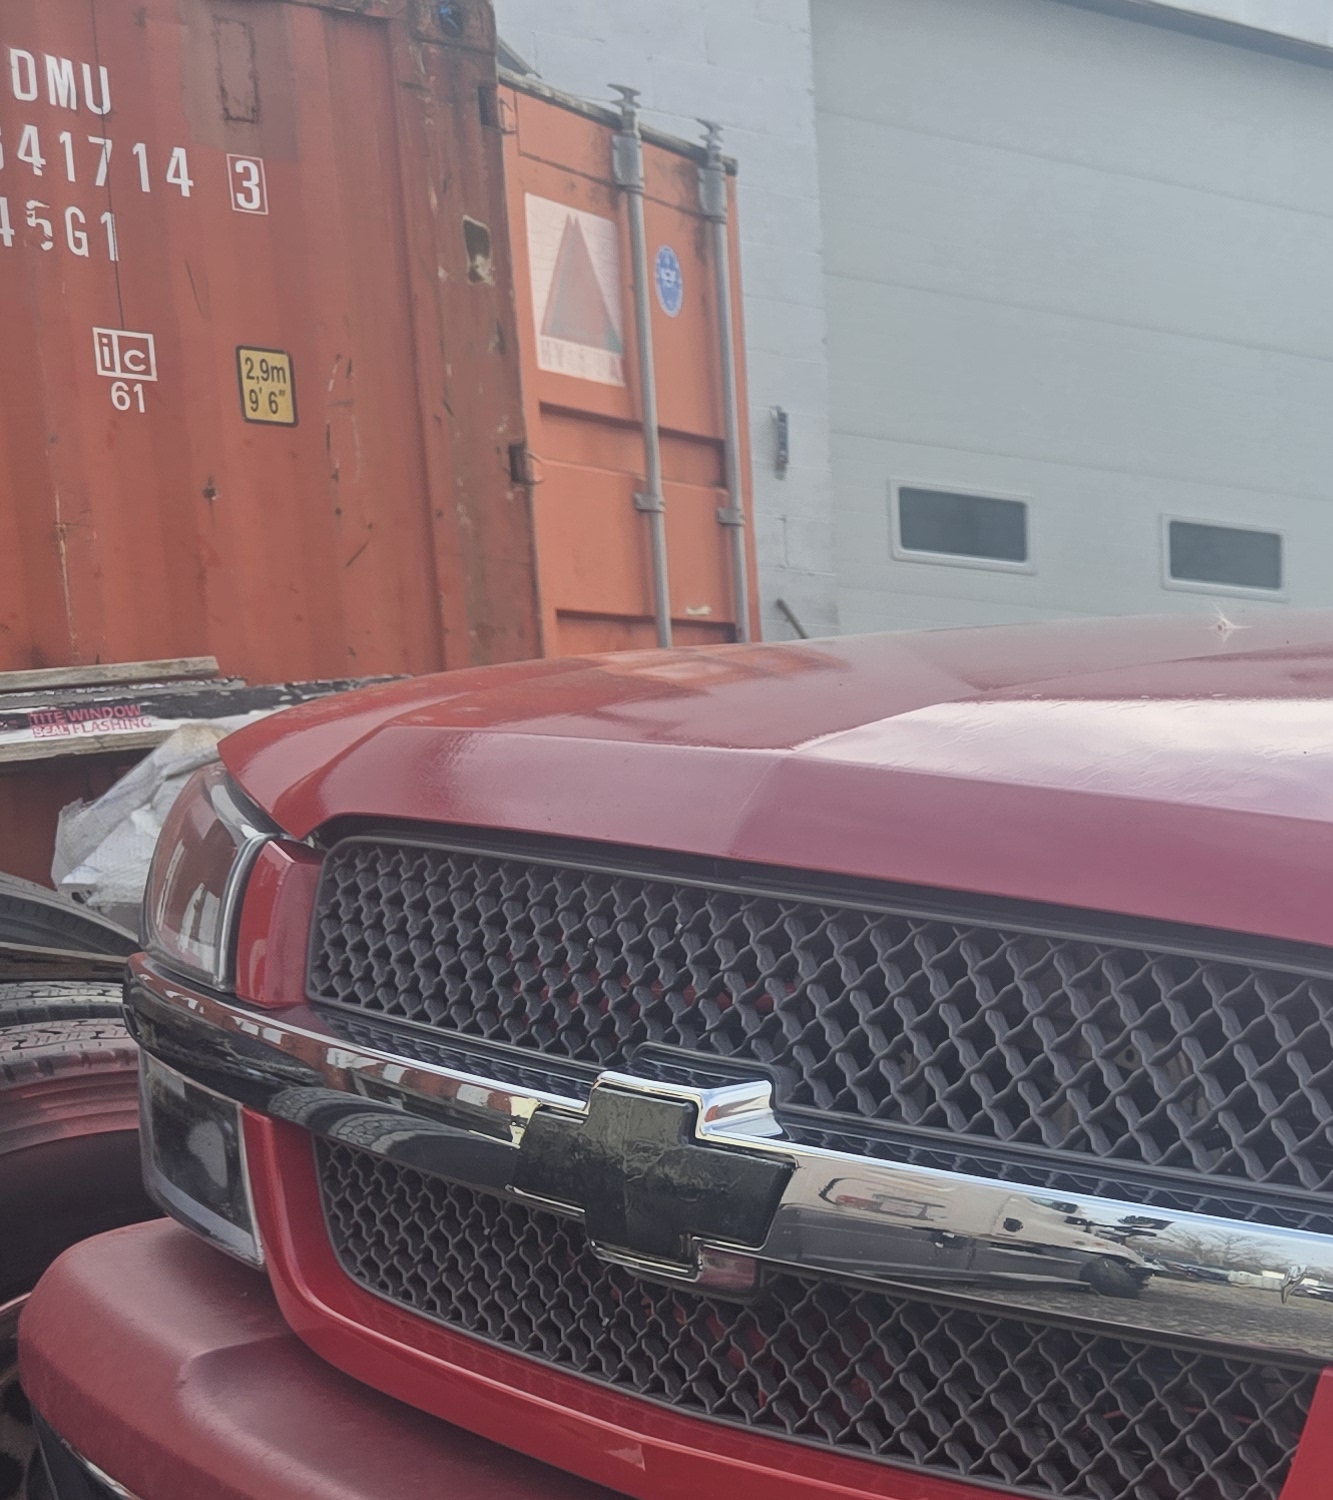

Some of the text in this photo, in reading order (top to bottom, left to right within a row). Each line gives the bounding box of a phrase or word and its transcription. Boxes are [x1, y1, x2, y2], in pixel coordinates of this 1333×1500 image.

[10, 48, 112, 115] DMU
[0, 124, 262, 210] 41714 3
[244, 356, 287, 385] 2,9m
[110, 381, 146, 413] 61
[30, 703, 142, 726] TITE WINDOW
[33, 715, 153, 738] SEAL FLASHING
